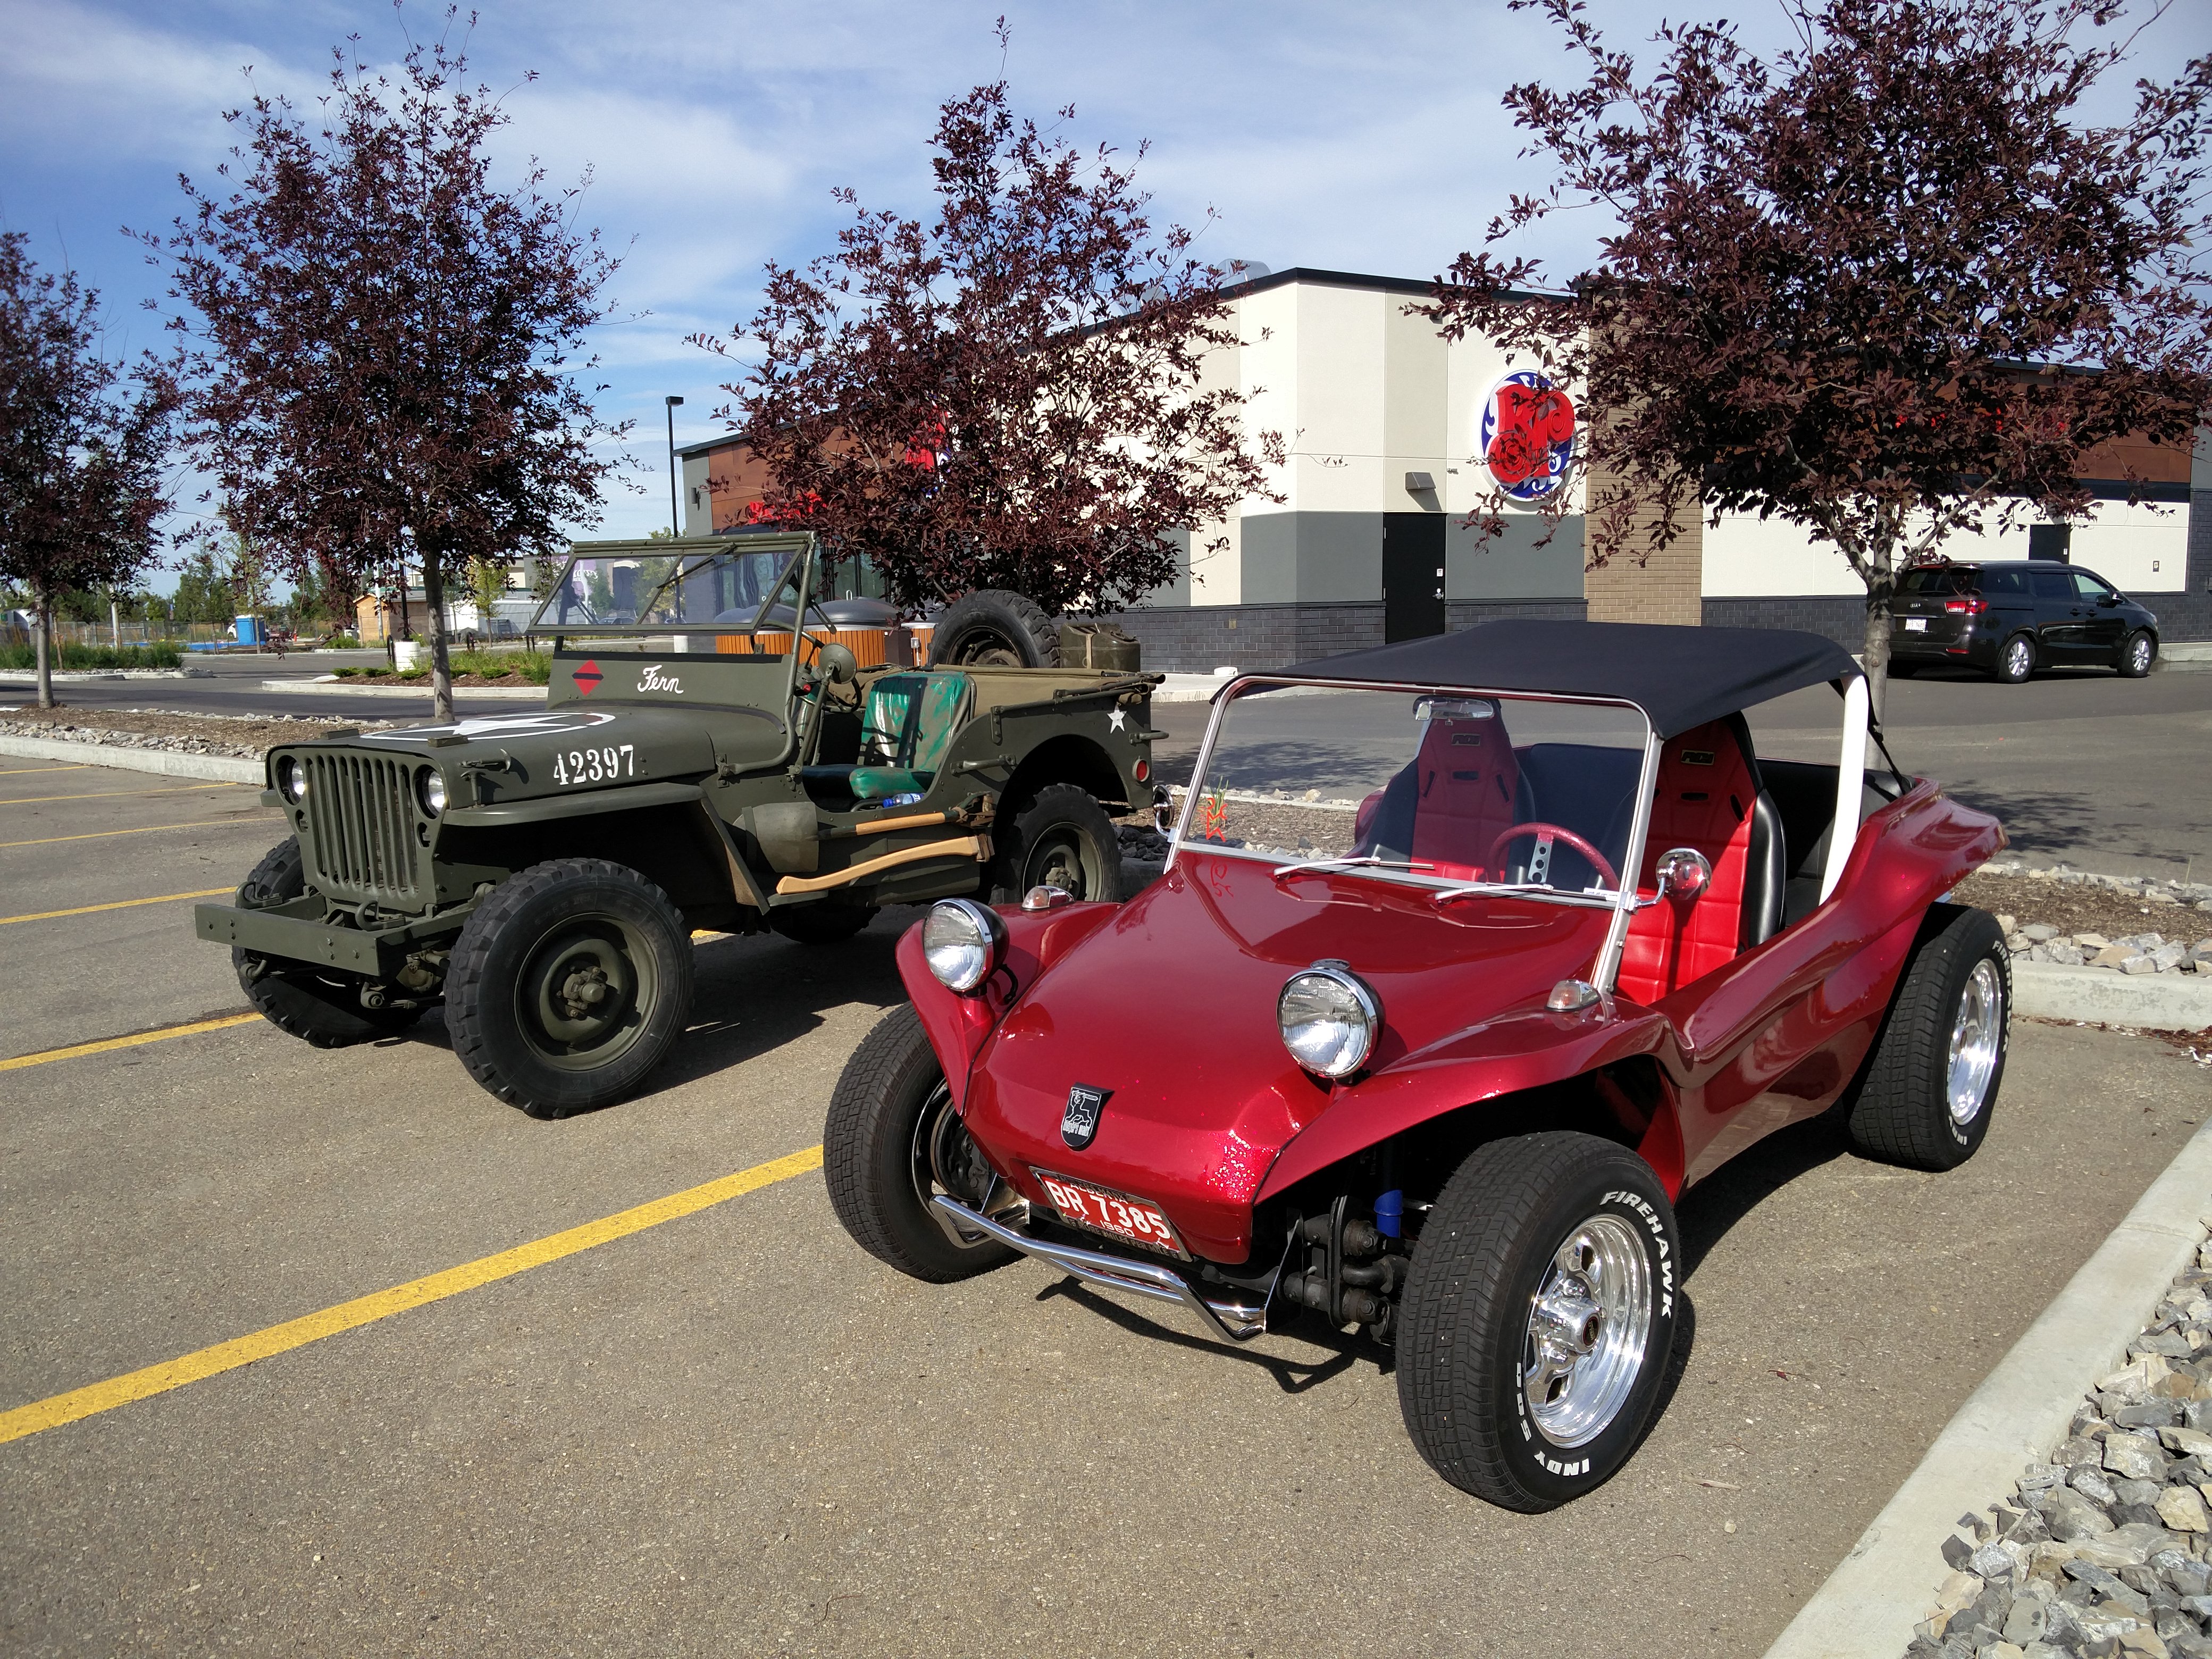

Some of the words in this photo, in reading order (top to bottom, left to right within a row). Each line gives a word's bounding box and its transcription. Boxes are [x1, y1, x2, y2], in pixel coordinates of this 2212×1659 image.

[637, 665, 684, 694] Fern
[554, 744, 634, 786] 42397
[1992, 940, 2012, 1052] FIREHAWK
[1045, 1180, 1090, 1216] BR
[1090, 1194, 1171, 1239] 7385
[1078, 1222, 1101, 1235] MORE
[1131, 1239, 1148, 1250] PER
[1100, 1220, 1135, 1237] 1960
[1599, 1191, 1673, 1319] FIREHAWK
[1534, 1450, 1590, 1476] INDY
